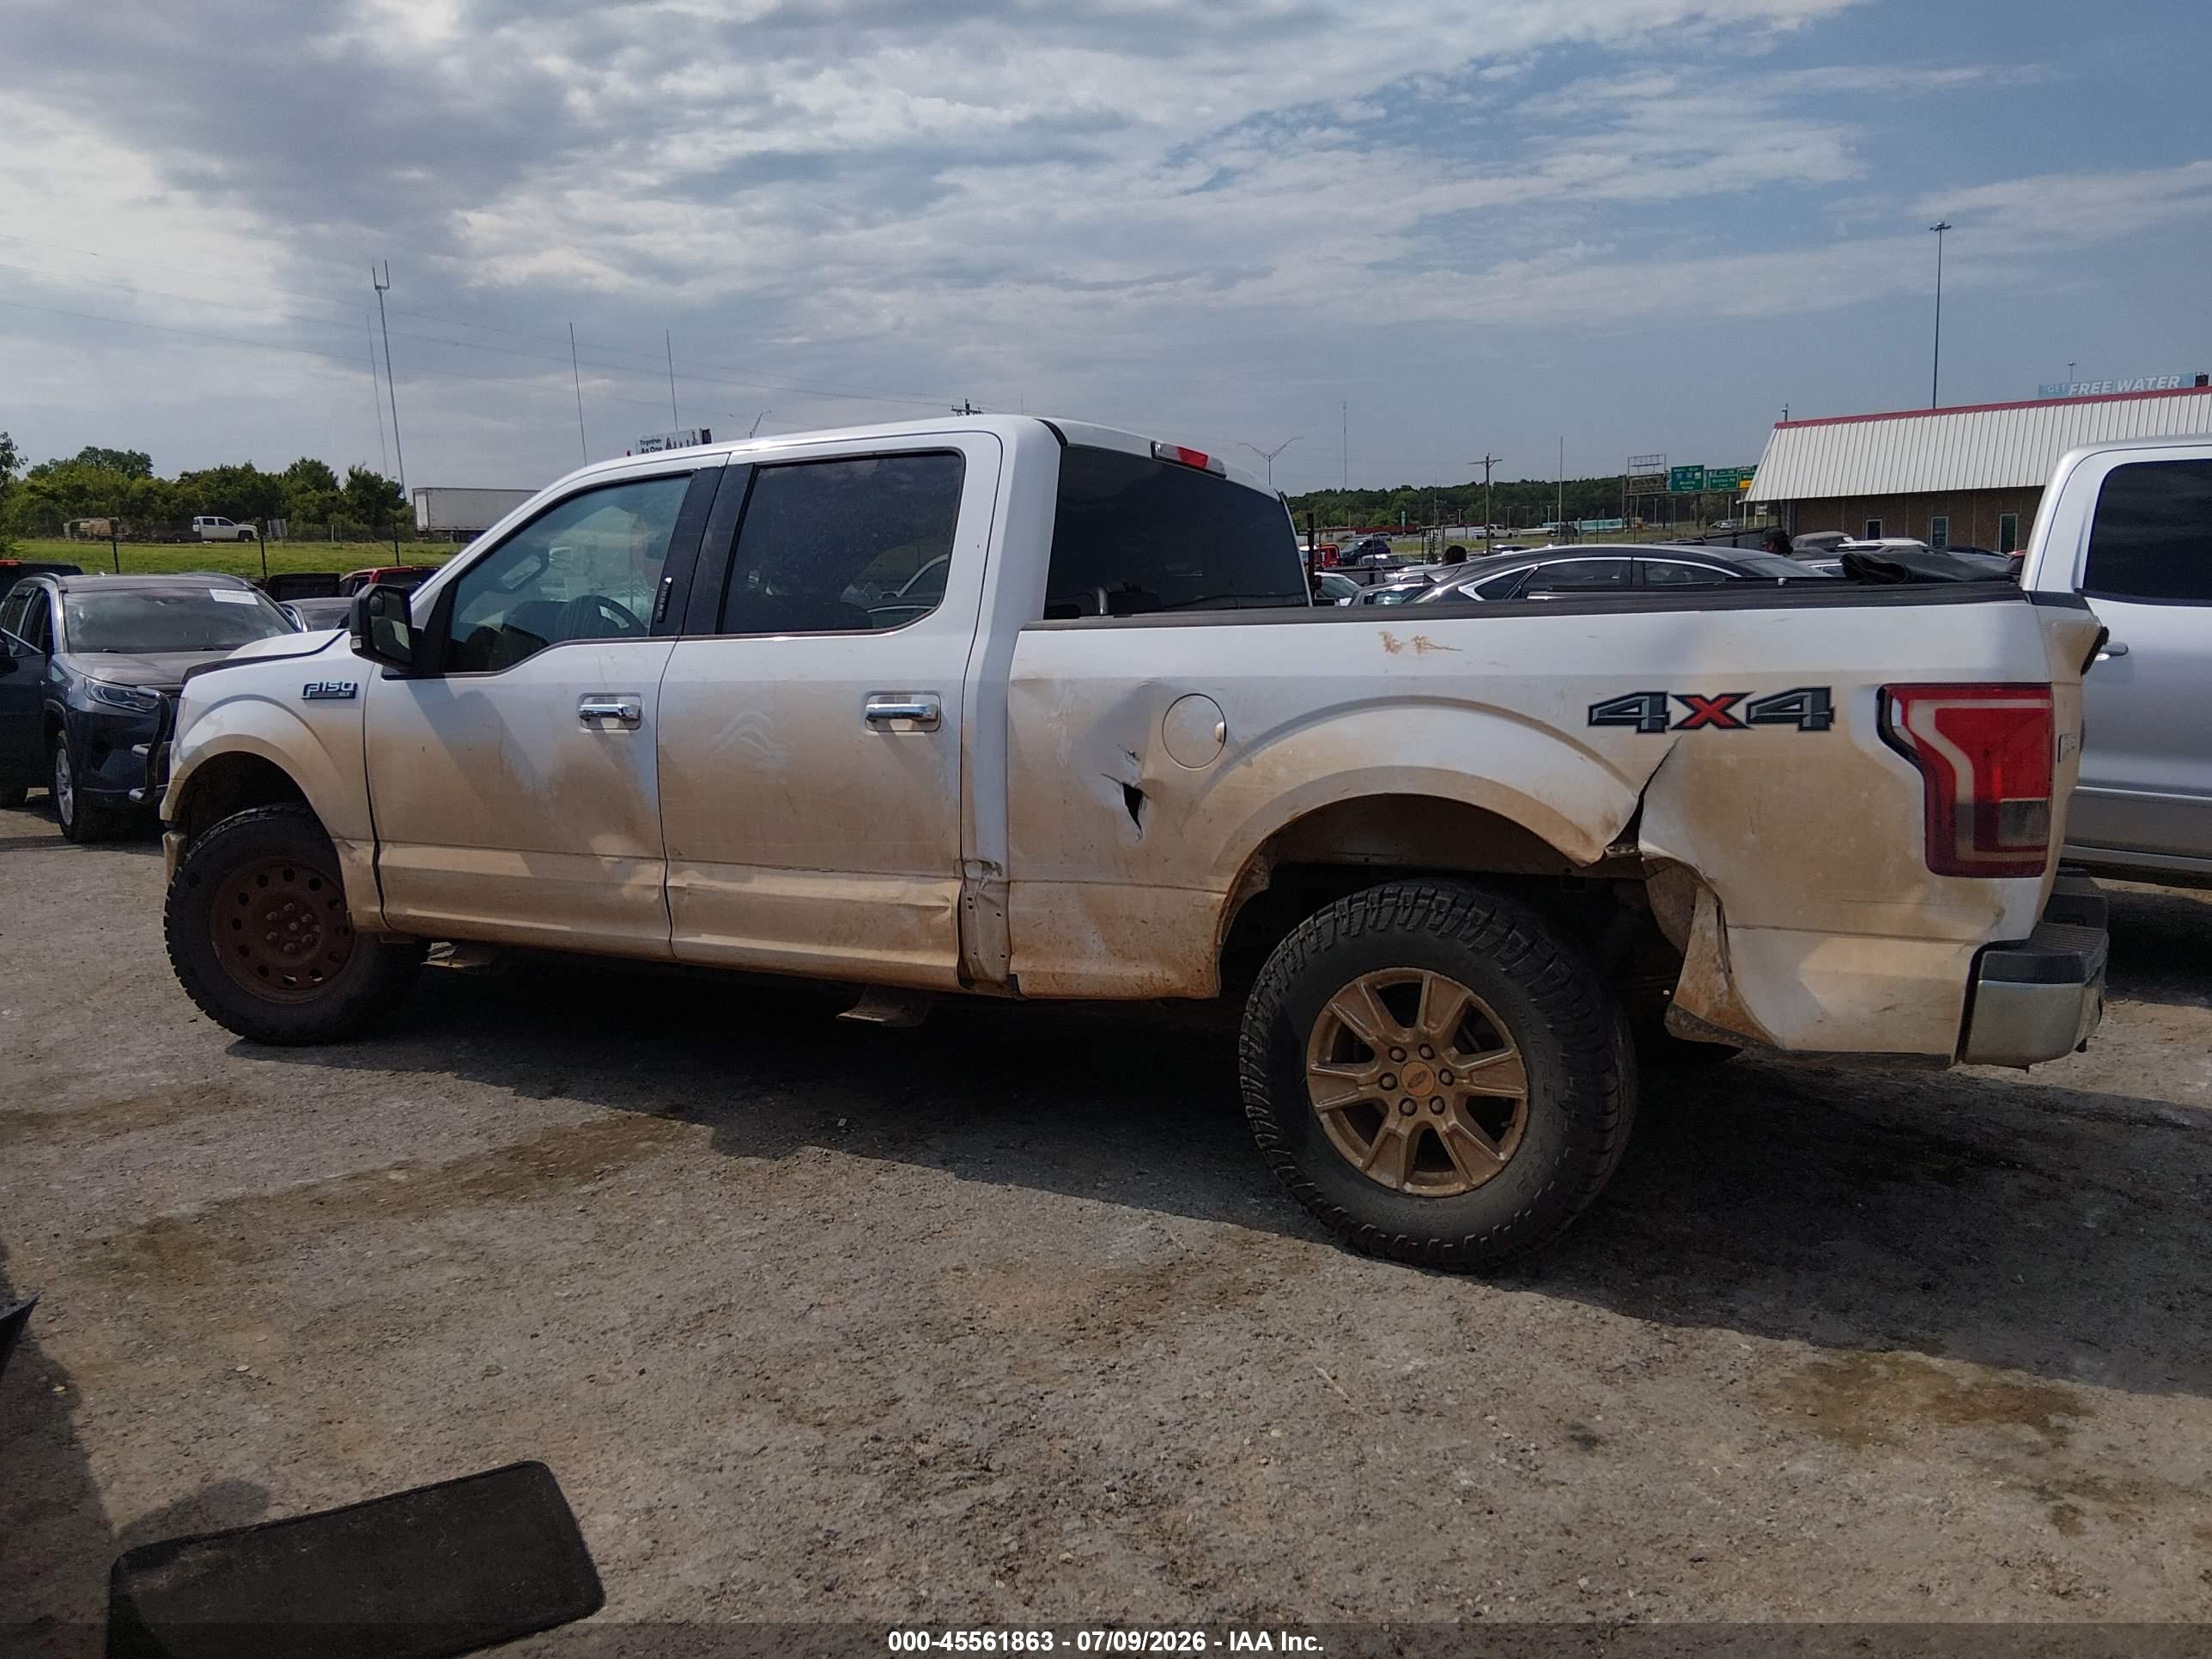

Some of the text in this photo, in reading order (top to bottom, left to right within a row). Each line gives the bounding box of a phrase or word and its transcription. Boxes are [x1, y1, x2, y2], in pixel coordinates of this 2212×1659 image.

[2048, 375, 2181, 396] GET FREE WATER
